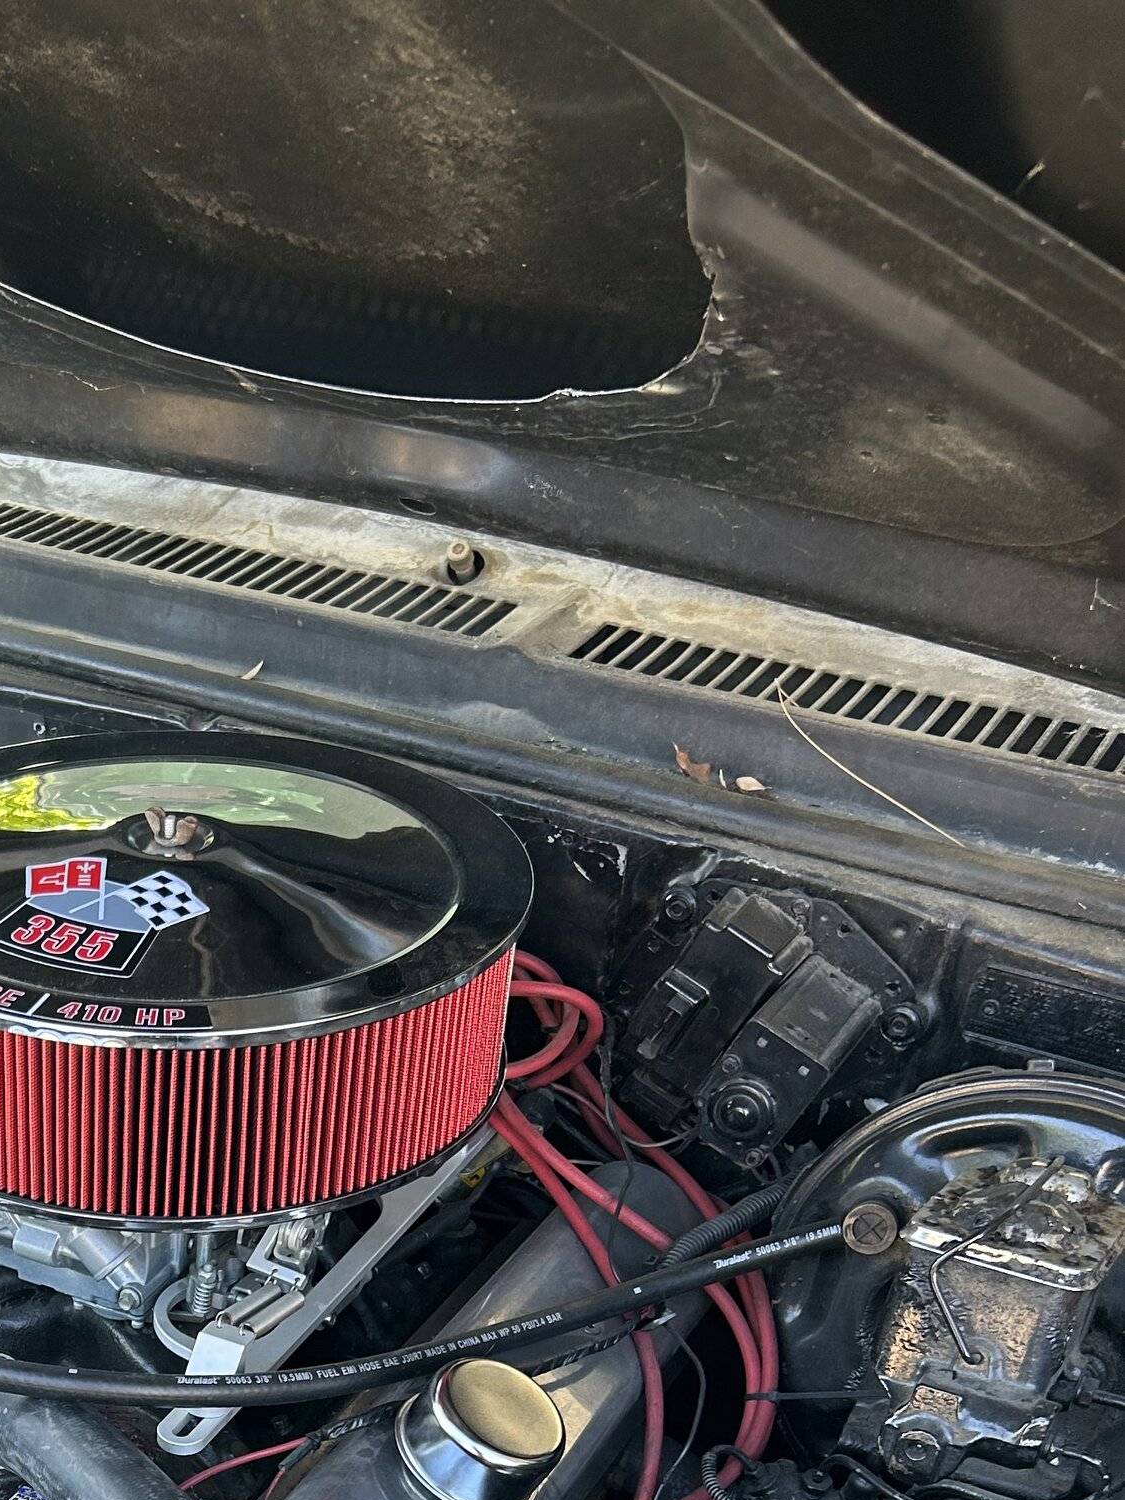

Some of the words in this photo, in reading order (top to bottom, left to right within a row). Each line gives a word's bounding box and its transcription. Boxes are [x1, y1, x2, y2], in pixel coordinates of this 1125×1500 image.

[10, 914, 119, 962] 355
[57, 1001, 122, 1023] 410
[135, 1008, 186, 1026] HP
[713, 1249, 752, 1270] Duralast
[755, 1241, 781, 1257] 50063
[805, 1224, 841, 1242] (9.5MM)
[278, 1373, 313, 1384] (9.5MM)
[316, 1368, 340, 1379] FUEL
[359, 1360, 382, 1373] HOSE
[383, 1354, 400, 1367] SAE
[424, 1344, 446, 1358] MADE
[448, 1342, 456, 1352] IN
[458, 1336, 480, 1349] CHINA
[481, 1331, 497, 1343] MAX
[499, 1326, 510, 1338] WP
[511, 1324, 521, 1334] 50
[545, 1312, 563, 1324] BAR
